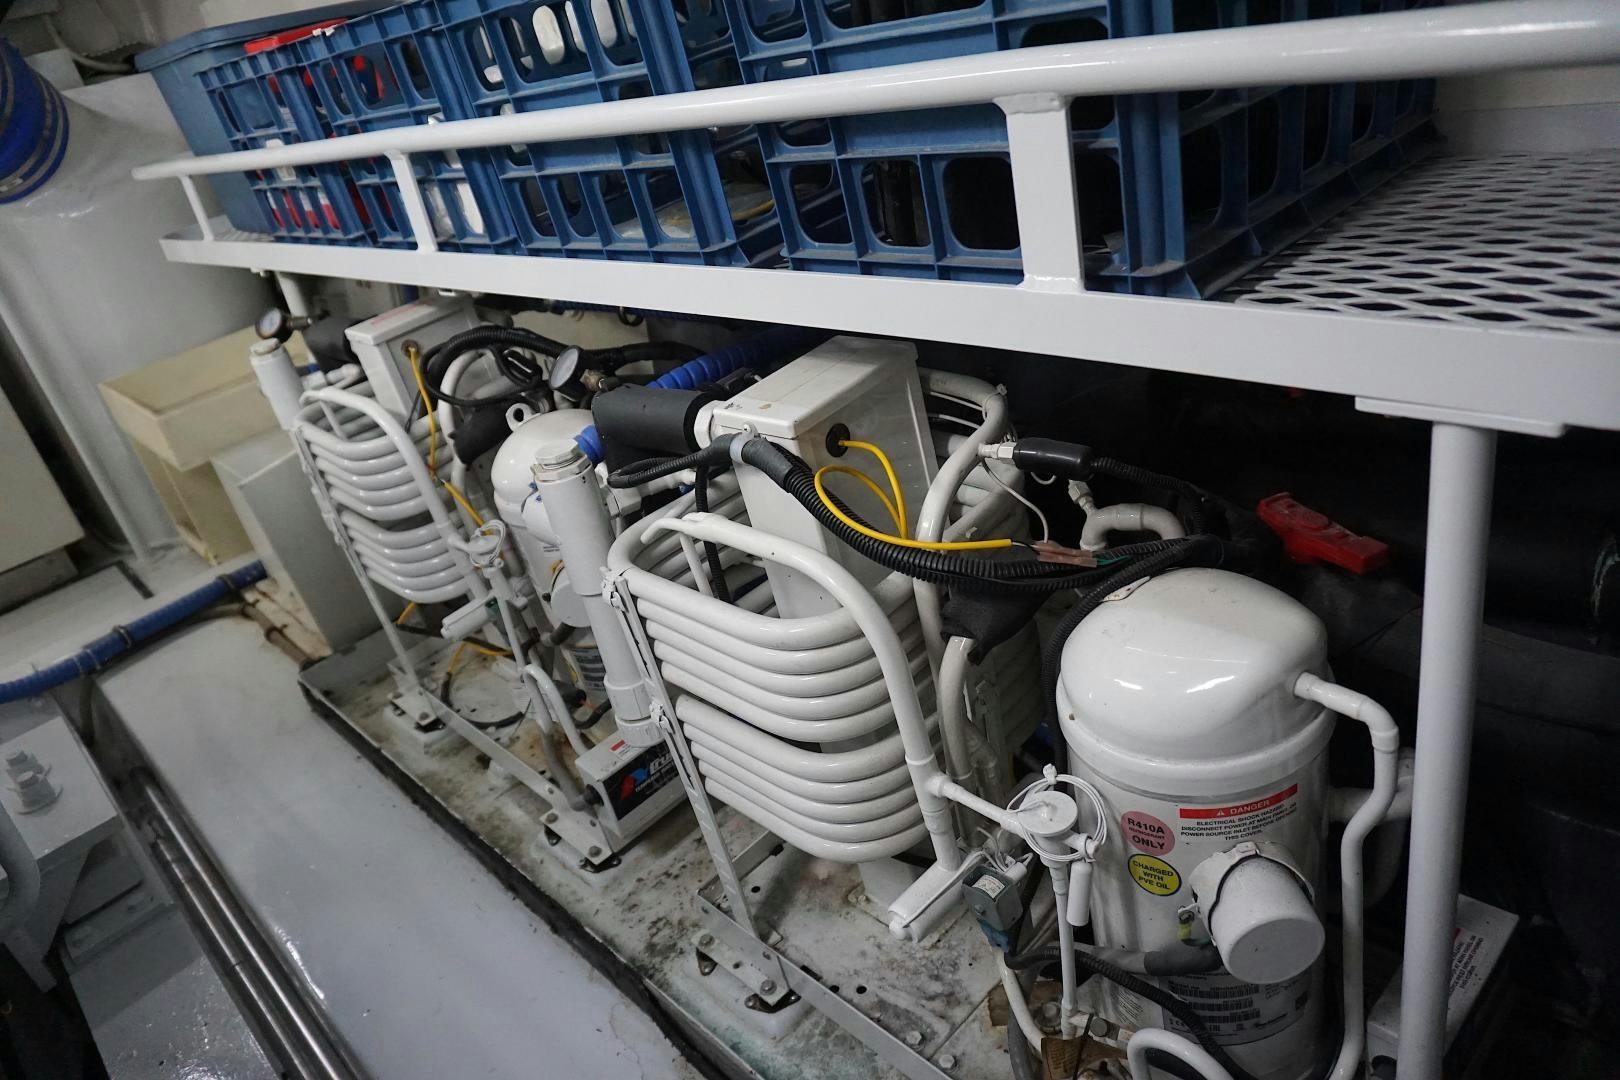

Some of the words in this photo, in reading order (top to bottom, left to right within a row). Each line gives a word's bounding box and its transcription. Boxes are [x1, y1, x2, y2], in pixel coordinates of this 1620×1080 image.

[1230, 799, 1271, 815] DANGER
[1127, 817, 1165, 834] R410A
[1196, 818, 1236, 826] ELECTRICAL
[1238, 814, 1260, 823] SHOCK
[1224, 821, 1248, 830] POWER
[1256, 815, 1271, 823] MAIN
[1233, 826, 1250, 834] INLET
[1252, 819, 1274, 830] BEFORE
[1132, 834, 1165, 850] ONLY
[1132, 860, 1174, 877] CHARGED
[1142, 870, 1164, 882] WITH
[1138, 875, 1154, 886] PVE
[1155, 881, 1170, 890] OIL
